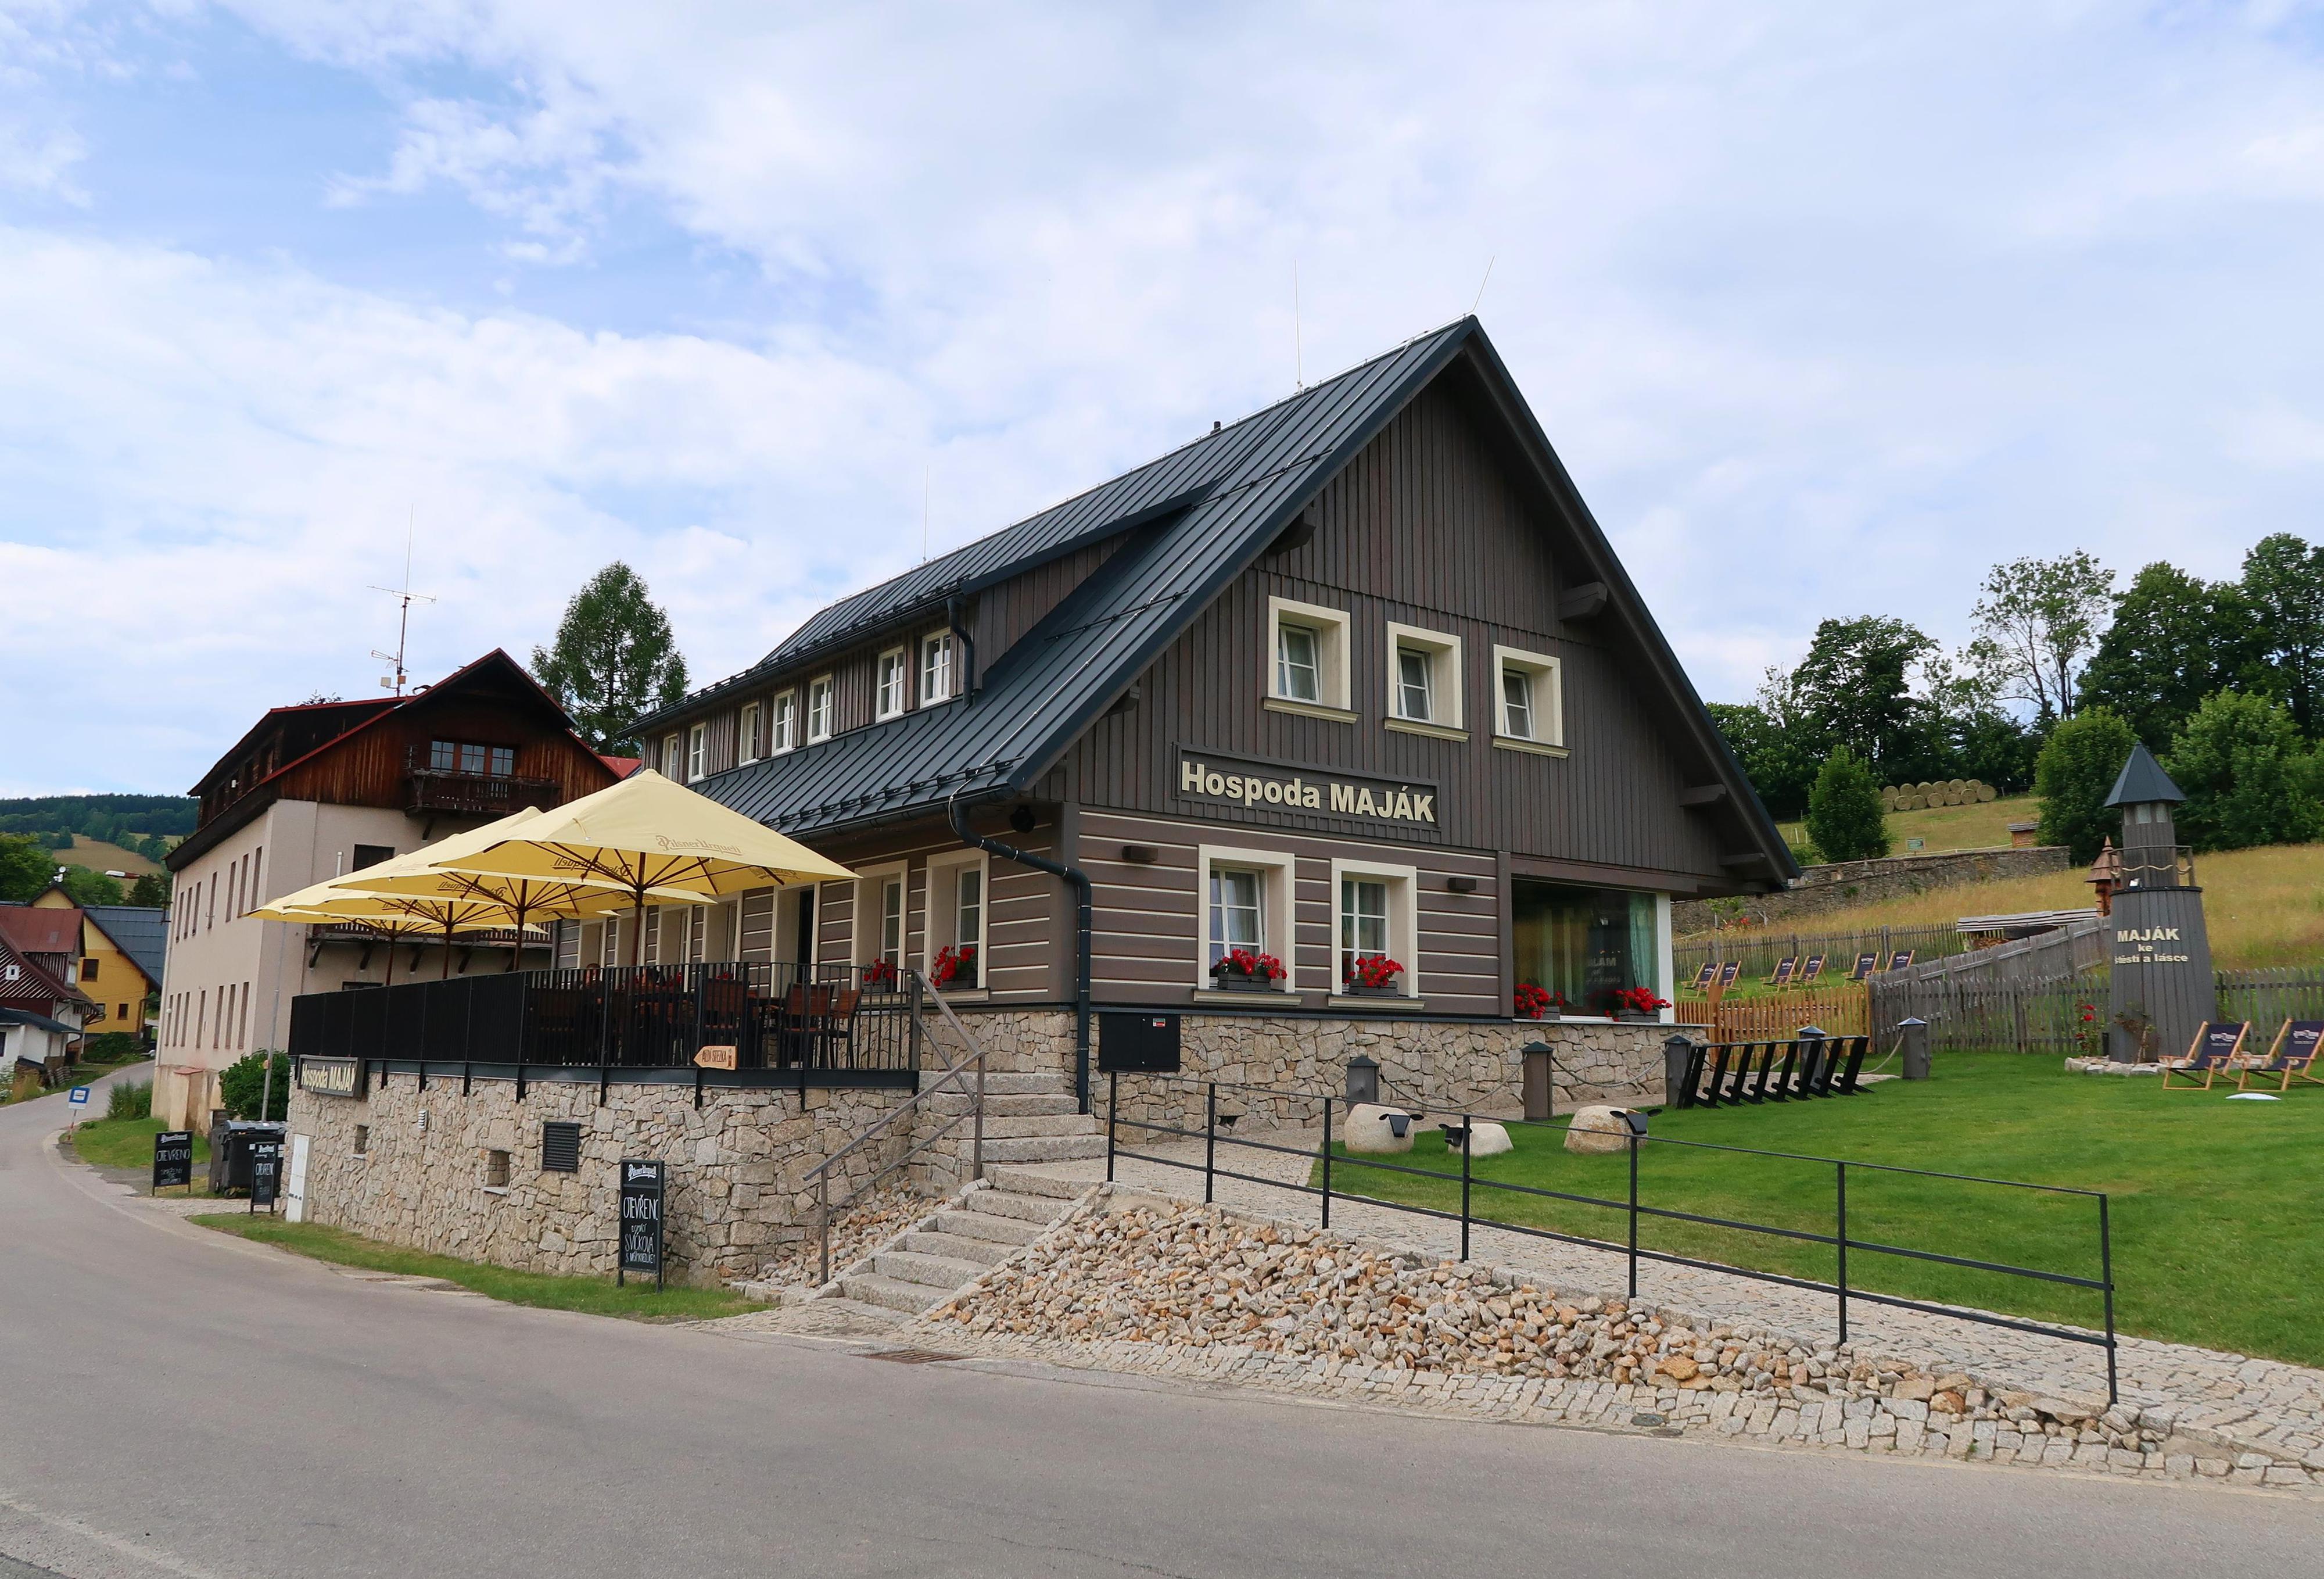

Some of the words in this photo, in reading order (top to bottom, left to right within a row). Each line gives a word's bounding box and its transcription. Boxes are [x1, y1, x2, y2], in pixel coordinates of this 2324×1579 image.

[1181, 761, 1320, 809] Hospoda
[1330, 783, 1434, 822] MAJÁK
[2117, 926, 2180, 942] MAJÁK
[2138, 944, 2153, 952] ke
[2154, 953, 2189, 962] lásce
[301, 1064, 328, 1091] Hospoda
